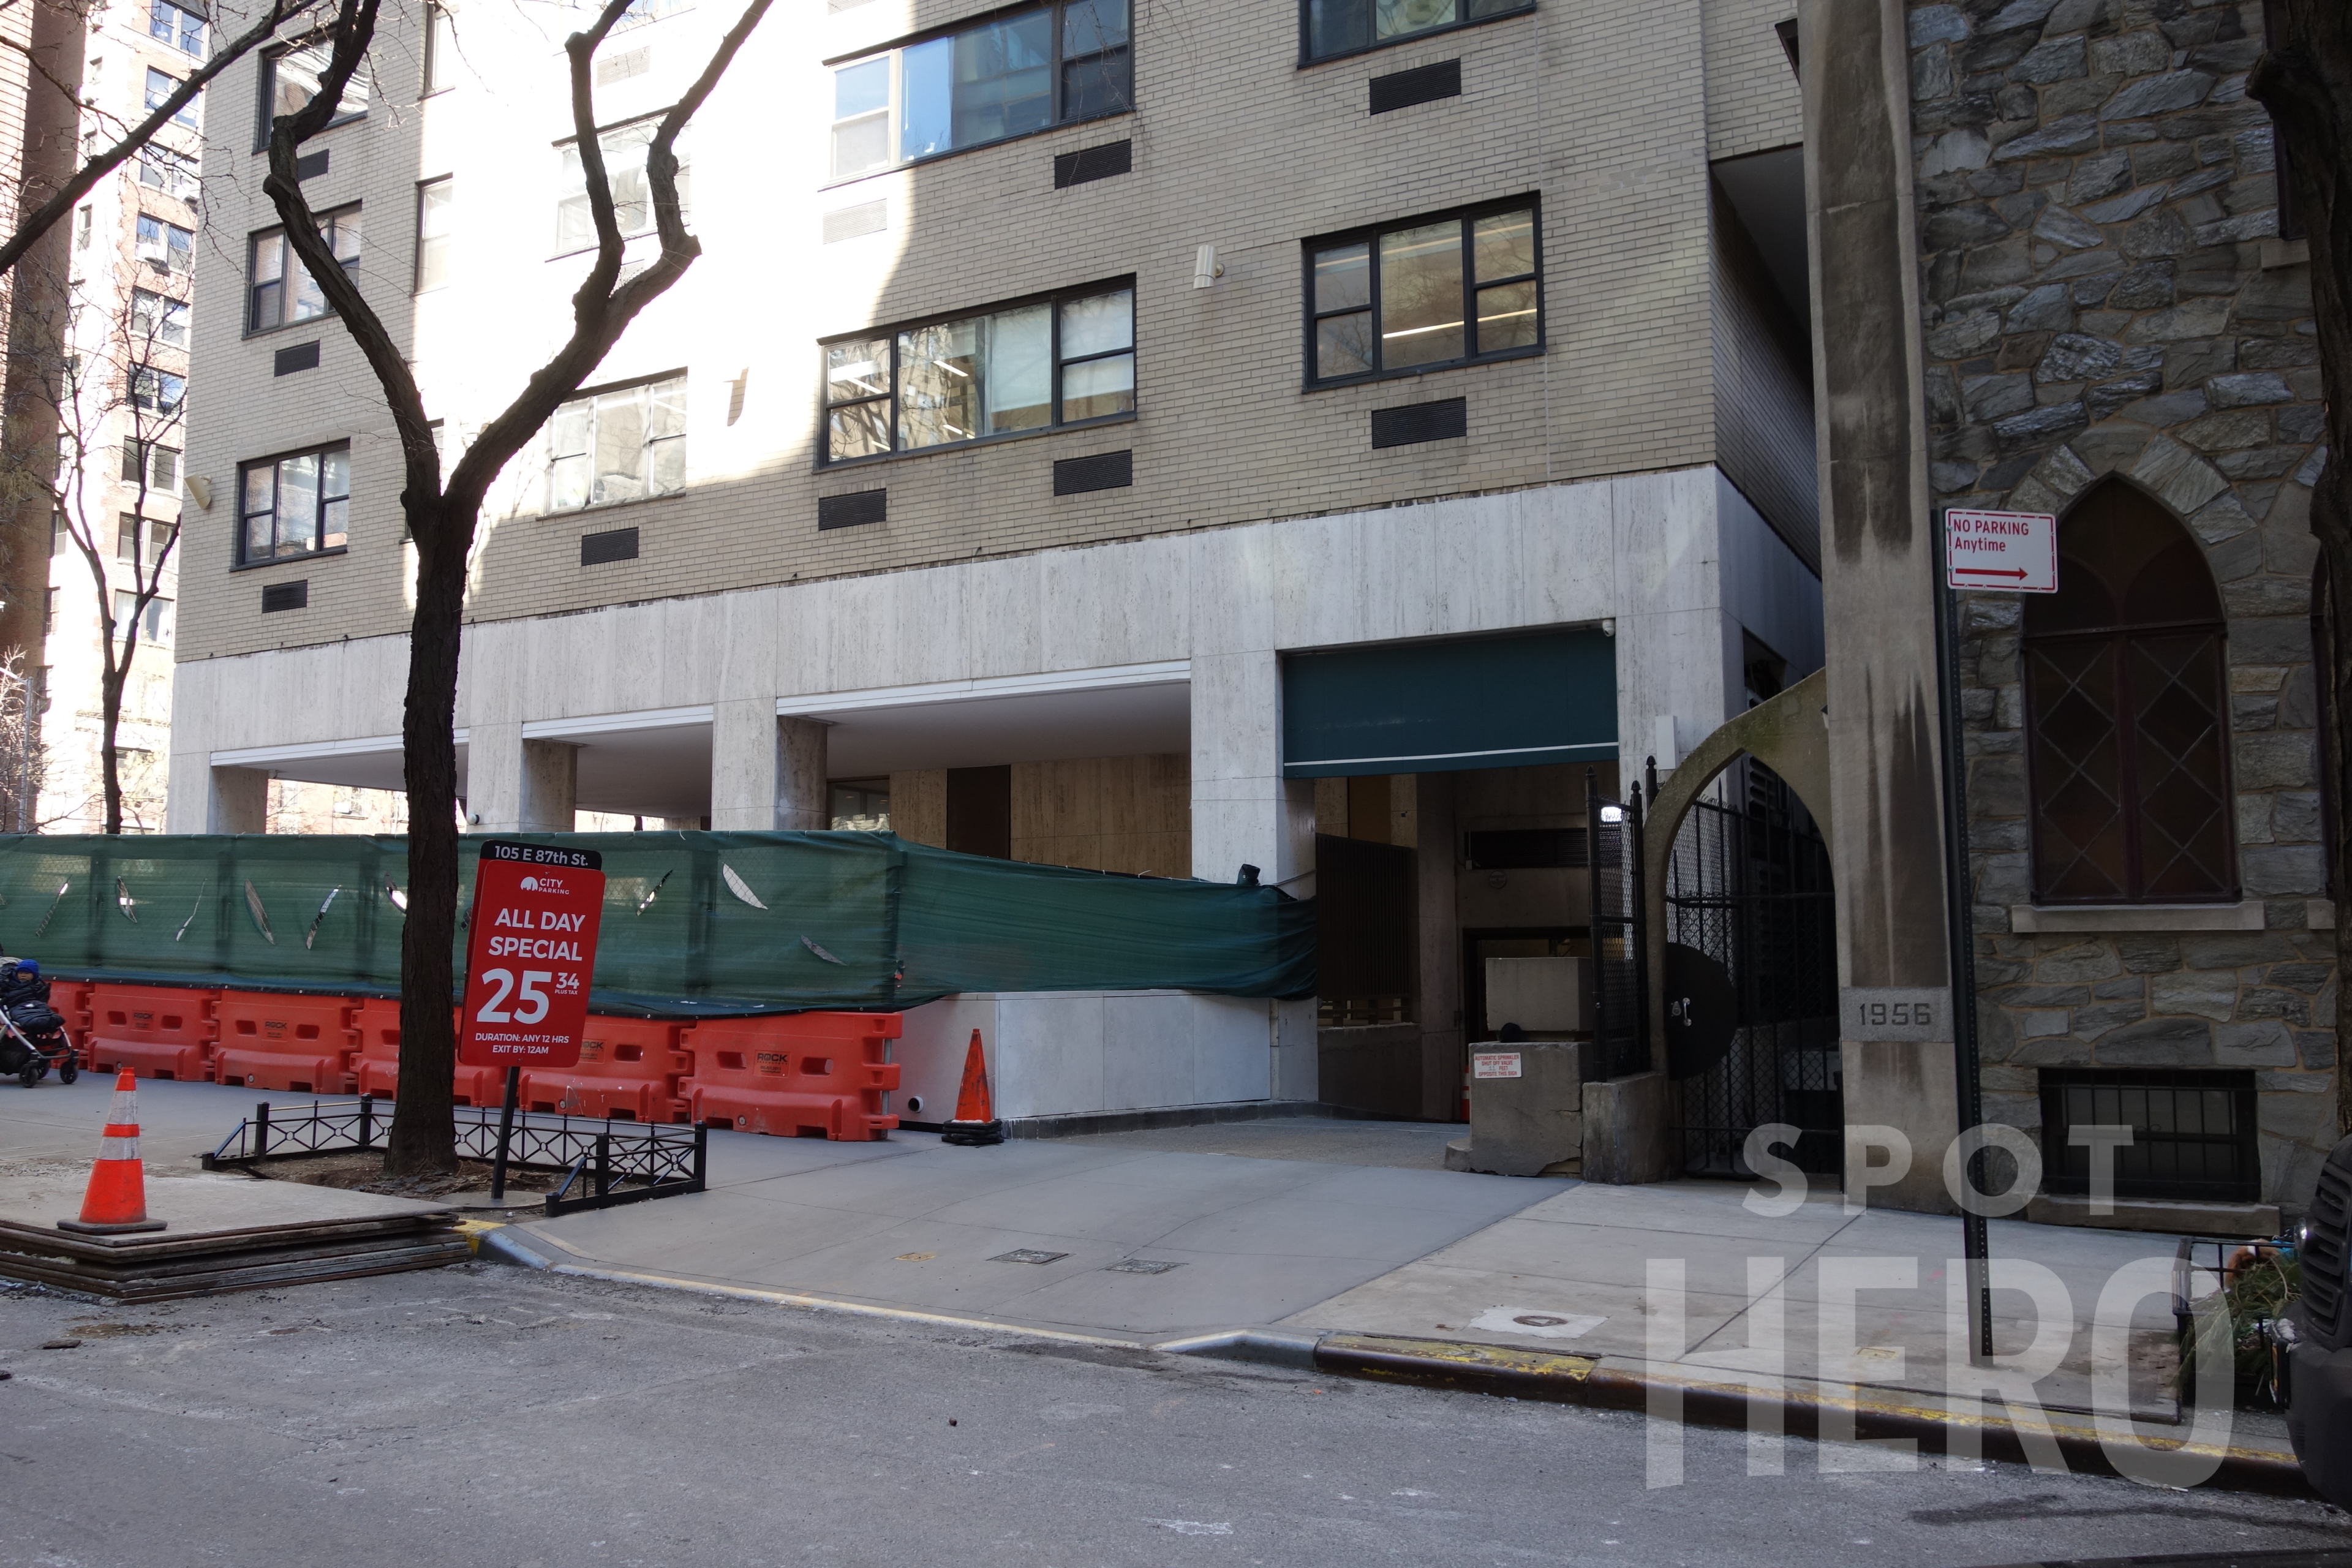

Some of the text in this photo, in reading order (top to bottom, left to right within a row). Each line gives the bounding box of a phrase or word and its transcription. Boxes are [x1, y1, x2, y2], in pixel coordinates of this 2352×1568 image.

[1953, 519, 2029, 535] NO PARKING
[1954, 537, 2006, 553] Anytime
[494, 845, 589, 865] 105 E 87th St.
[540, 878, 563, 888] CITY
[494, 908, 586, 932] ALL DAY
[488, 936, 582, 961] SPECIAL
[477, 968, 580, 1024] 25 34
[1859, 1003, 1931, 1025] 1956
[475, 1033, 521, 1041] DURATION:
[581, 1041, 604, 1049] OCK
[492, 1044, 549, 1054] EXIT BY: 12AM
[757, 1053, 788, 1063] ROCK
